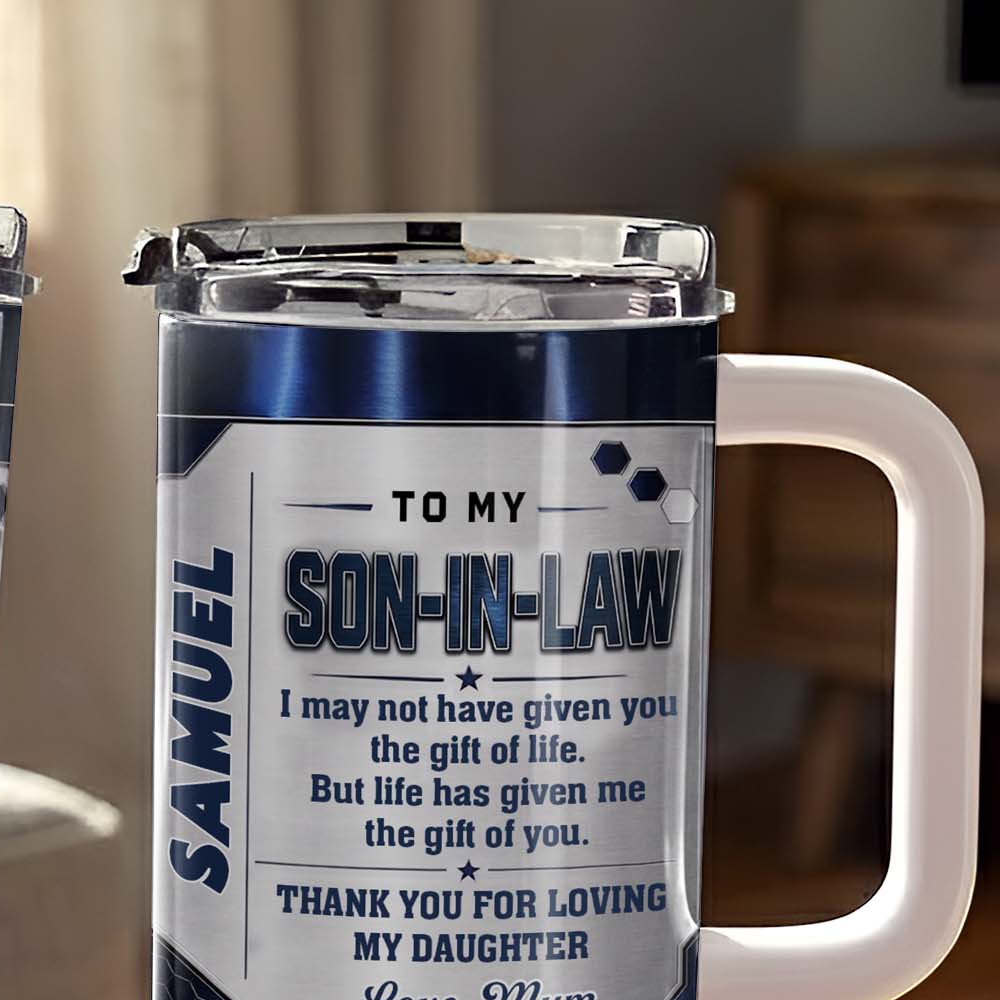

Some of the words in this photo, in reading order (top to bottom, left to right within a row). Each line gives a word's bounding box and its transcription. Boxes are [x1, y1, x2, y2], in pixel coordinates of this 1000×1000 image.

[393, 490, 447, 524] TO
[468, 490, 526, 524] MY
[284, 547, 682, 653] SON-IN-LAW
[169, 546, 233, 893] SAMUEL
[280, 688, 292, 718] I
[302, 693, 369, 726] may
[378, 696, 428, 723] not
[437, 693, 513, 723] have
[524, 693, 611, 729] given
[621, 694, 678, 725] you
[370, 734, 421, 763] the
[430, 735, 481, 770] gift
[490, 735, 522, 764] of
[528, 735, 586, 763] life.
[311, 774, 364, 806] But
[374, 776, 423, 807] life
[432, 776, 490, 807] has
[500, 775, 588, 814] given
[598, 778, 646, 803] me
[365, 819, 415, 848] the
[424, 818, 476, 856] gift
[485, 818, 516, 848] of
[526, 821, 589, 854] you.
[276, 883, 390, 917] THANK
[399, 888, 463, 920] YOU
[473, 889, 536, 919] FOR
[547, 882, 666, 918] LOVING
[353, 932, 403, 962] MY
[411, 930, 588, 963] DAUGHTER
